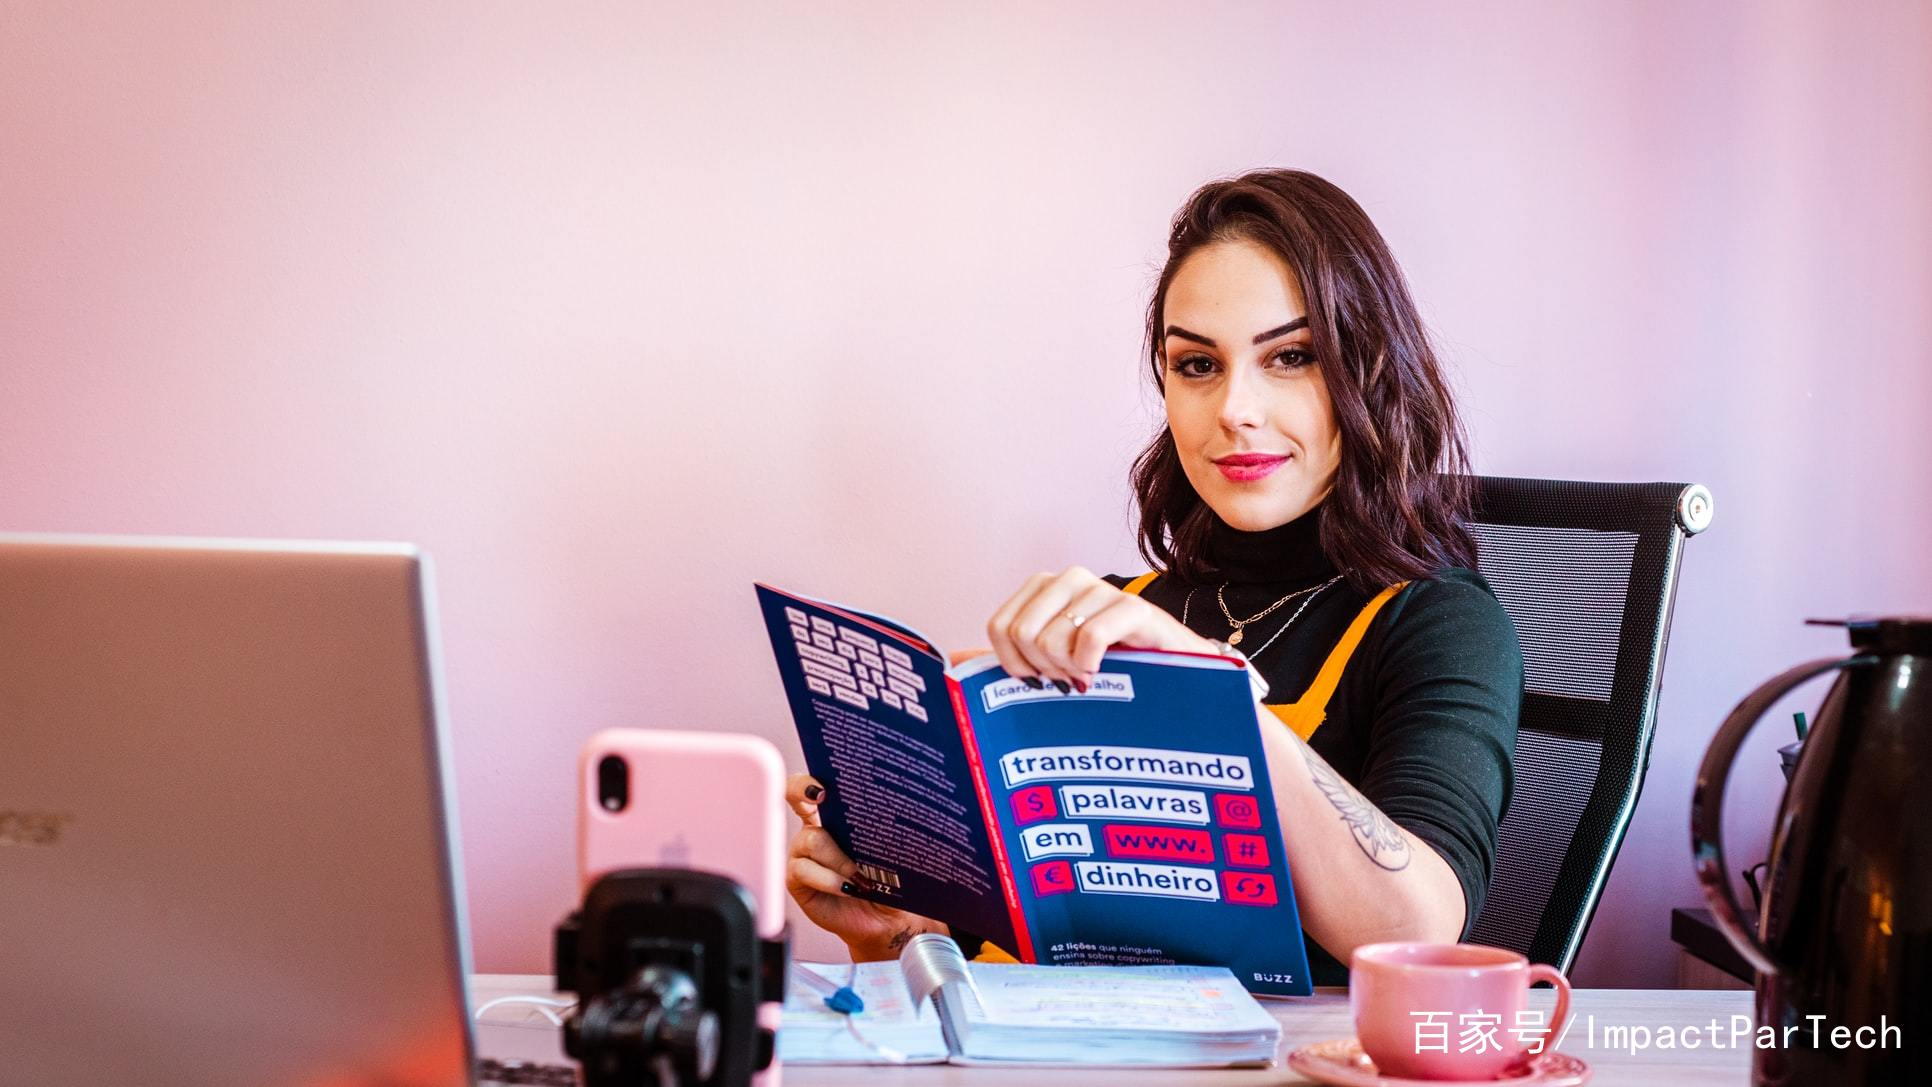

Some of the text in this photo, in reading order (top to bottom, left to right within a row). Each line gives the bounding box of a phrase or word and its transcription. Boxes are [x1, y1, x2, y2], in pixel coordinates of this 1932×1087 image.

[1012, 749, 1245, 780] transformando
[1026, 788, 1253, 822] $ palavras @
[1035, 831, 1257, 858] em www. #
[1086, 865, 1213, 893] dinheiro
[1050, 942, 1162, 955] 42 lições que ninguém
[1053, 951, 1176, 967] ensina sobre copywriting
